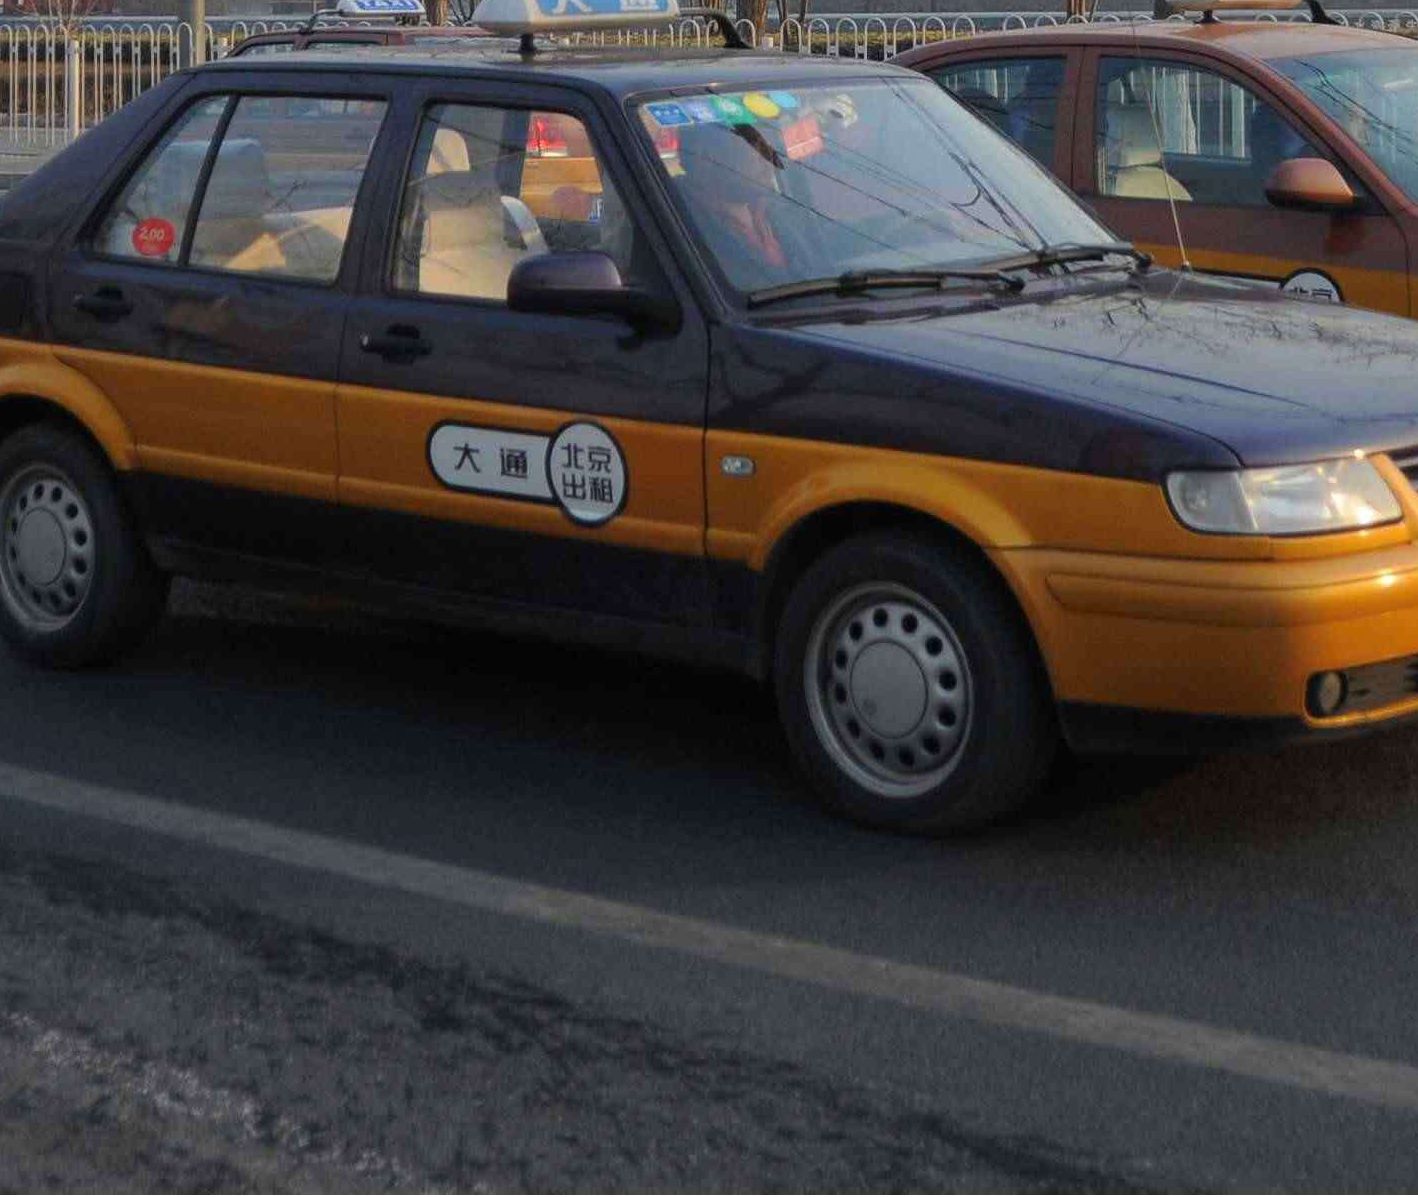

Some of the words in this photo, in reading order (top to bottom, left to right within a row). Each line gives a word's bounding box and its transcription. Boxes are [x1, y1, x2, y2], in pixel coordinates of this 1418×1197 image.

[453, 443, 528, 479] 大通
[561, 443, 612, 473] 北京
[562, 473, 613, 504] 出租
